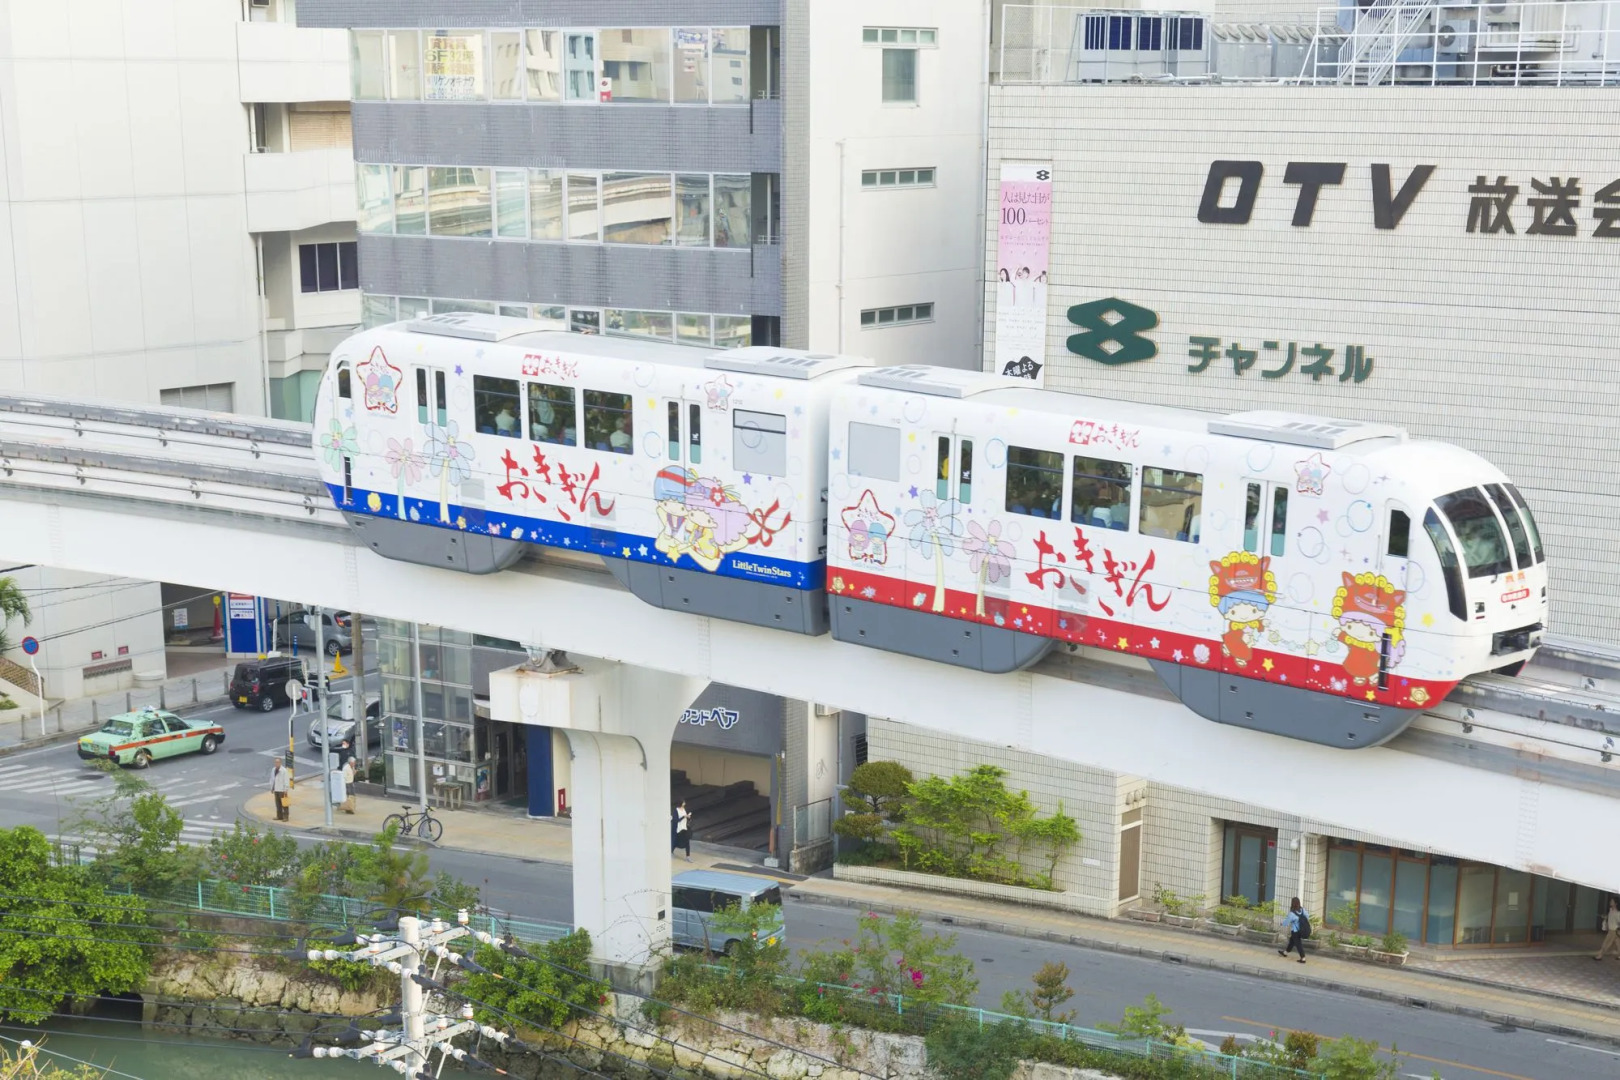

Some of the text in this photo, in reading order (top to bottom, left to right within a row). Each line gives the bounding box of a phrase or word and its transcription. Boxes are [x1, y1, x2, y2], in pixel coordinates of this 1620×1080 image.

[1003, 191, 1050, 204] 人は見た目が
[1197, 160, 1437, 230] OTV
[1187, 335, 1374, 384] チャンネル
[496, 444, 616, 522] おきぎん
[1025, 526, 1173, 617] おきぎん
